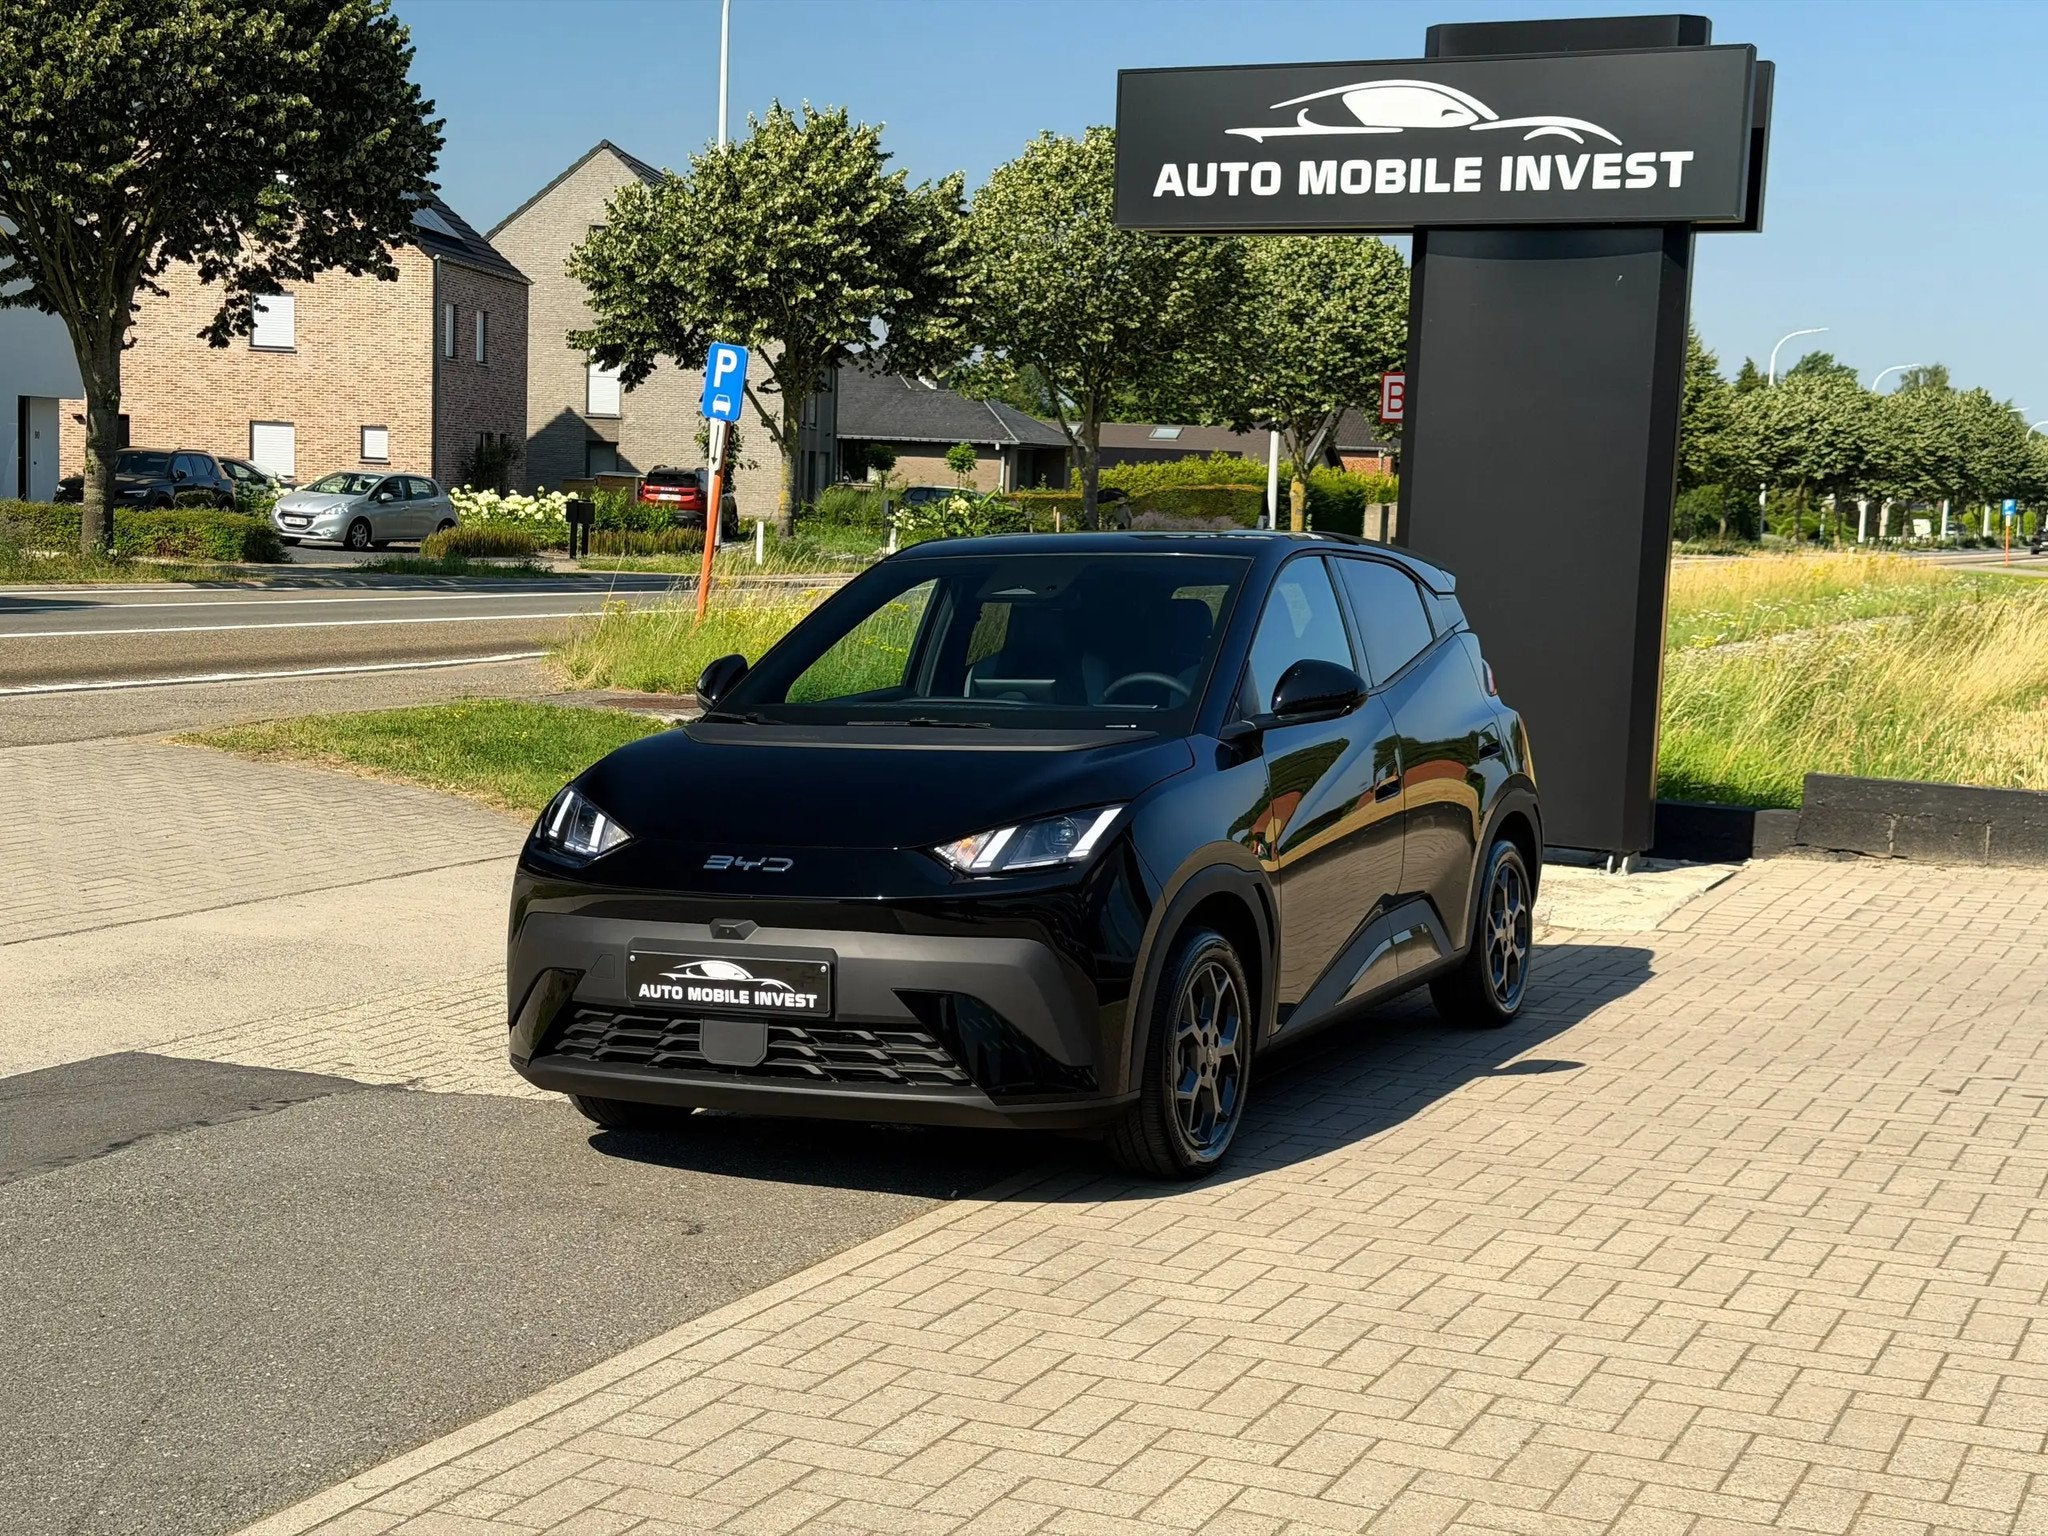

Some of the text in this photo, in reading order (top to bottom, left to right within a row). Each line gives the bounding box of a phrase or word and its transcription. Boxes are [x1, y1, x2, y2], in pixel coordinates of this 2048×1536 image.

[1153, 151, 1694, 197] AUTO MOBILE INVEST
[713, 348, 738, 388] P
[703, 855, 794, 871] BYD
[639, 983, 817, 1008] AUTO MOBILE INVEST
